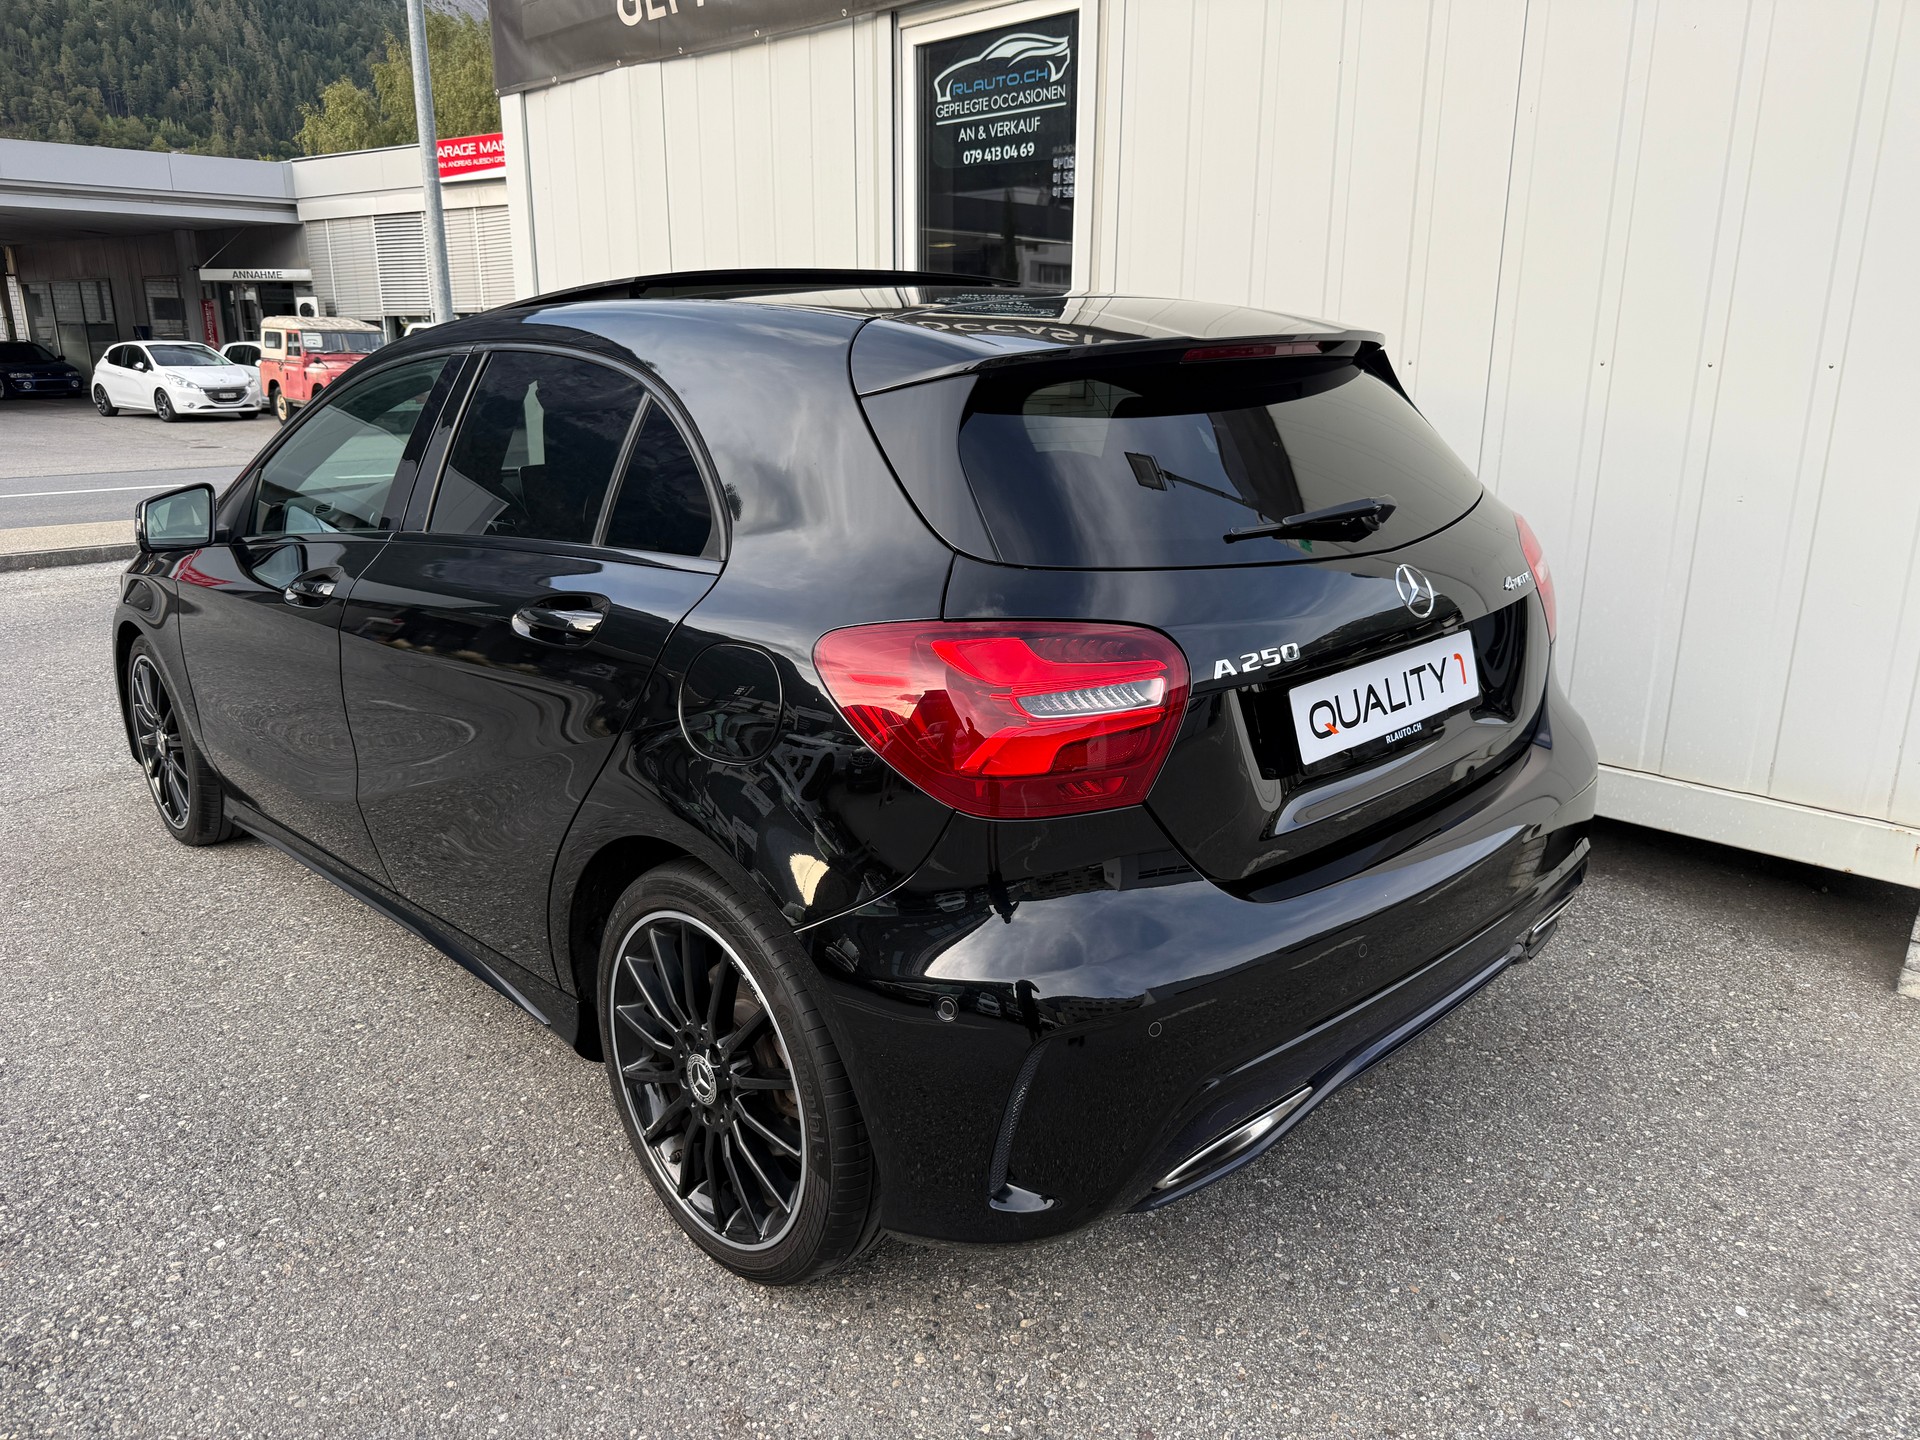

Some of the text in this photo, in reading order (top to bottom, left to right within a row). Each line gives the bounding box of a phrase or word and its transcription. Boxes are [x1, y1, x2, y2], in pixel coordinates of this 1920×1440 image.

[953, 68, 1049, 96] RLAUTO.CH
[936, 84, 1066, 118] GEPFLEGTE OCCASIONEN
[958, 116, 1041, 142] AN & VERKAUF
[437, 143, 477, 158] ARAGE
[963, 148, 982, 165] 079
[984, 146, 1001, 162] 413
[1003, 144, 1018, 159] 04
[1020, 142, 1035, 157] 69
[448, 158, 472, 168] ANDREAS
[232, 270, 283, 279] ANNAHME
[1213, 643, 1300, 679] A 250
[1309, 653, 1467, 739] QUALITY 1
[1385, 722, 1422, 745] RLAUTO.CH
